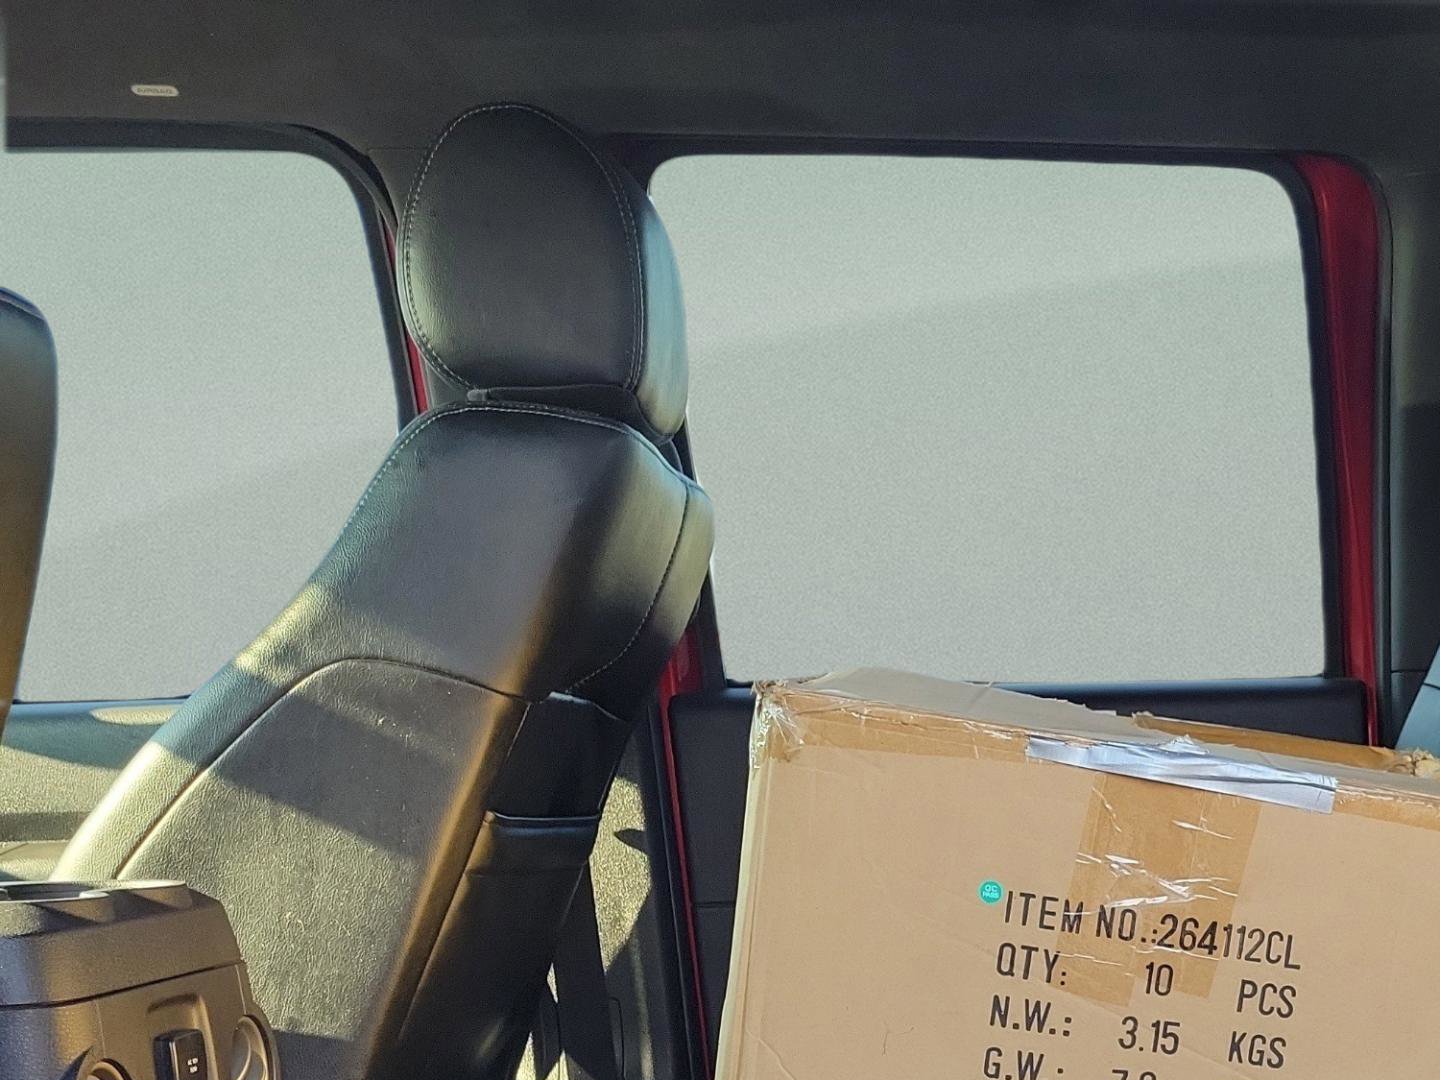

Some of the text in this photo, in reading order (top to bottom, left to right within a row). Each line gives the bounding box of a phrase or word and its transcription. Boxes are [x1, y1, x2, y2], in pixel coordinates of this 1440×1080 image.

[1004, 890, 1084, 934] ITEM
[996, 942, 1297, 1018] QTY: 10 PCS
[990, 994, 1287, 1069] N.W.: 3.15 KGS
